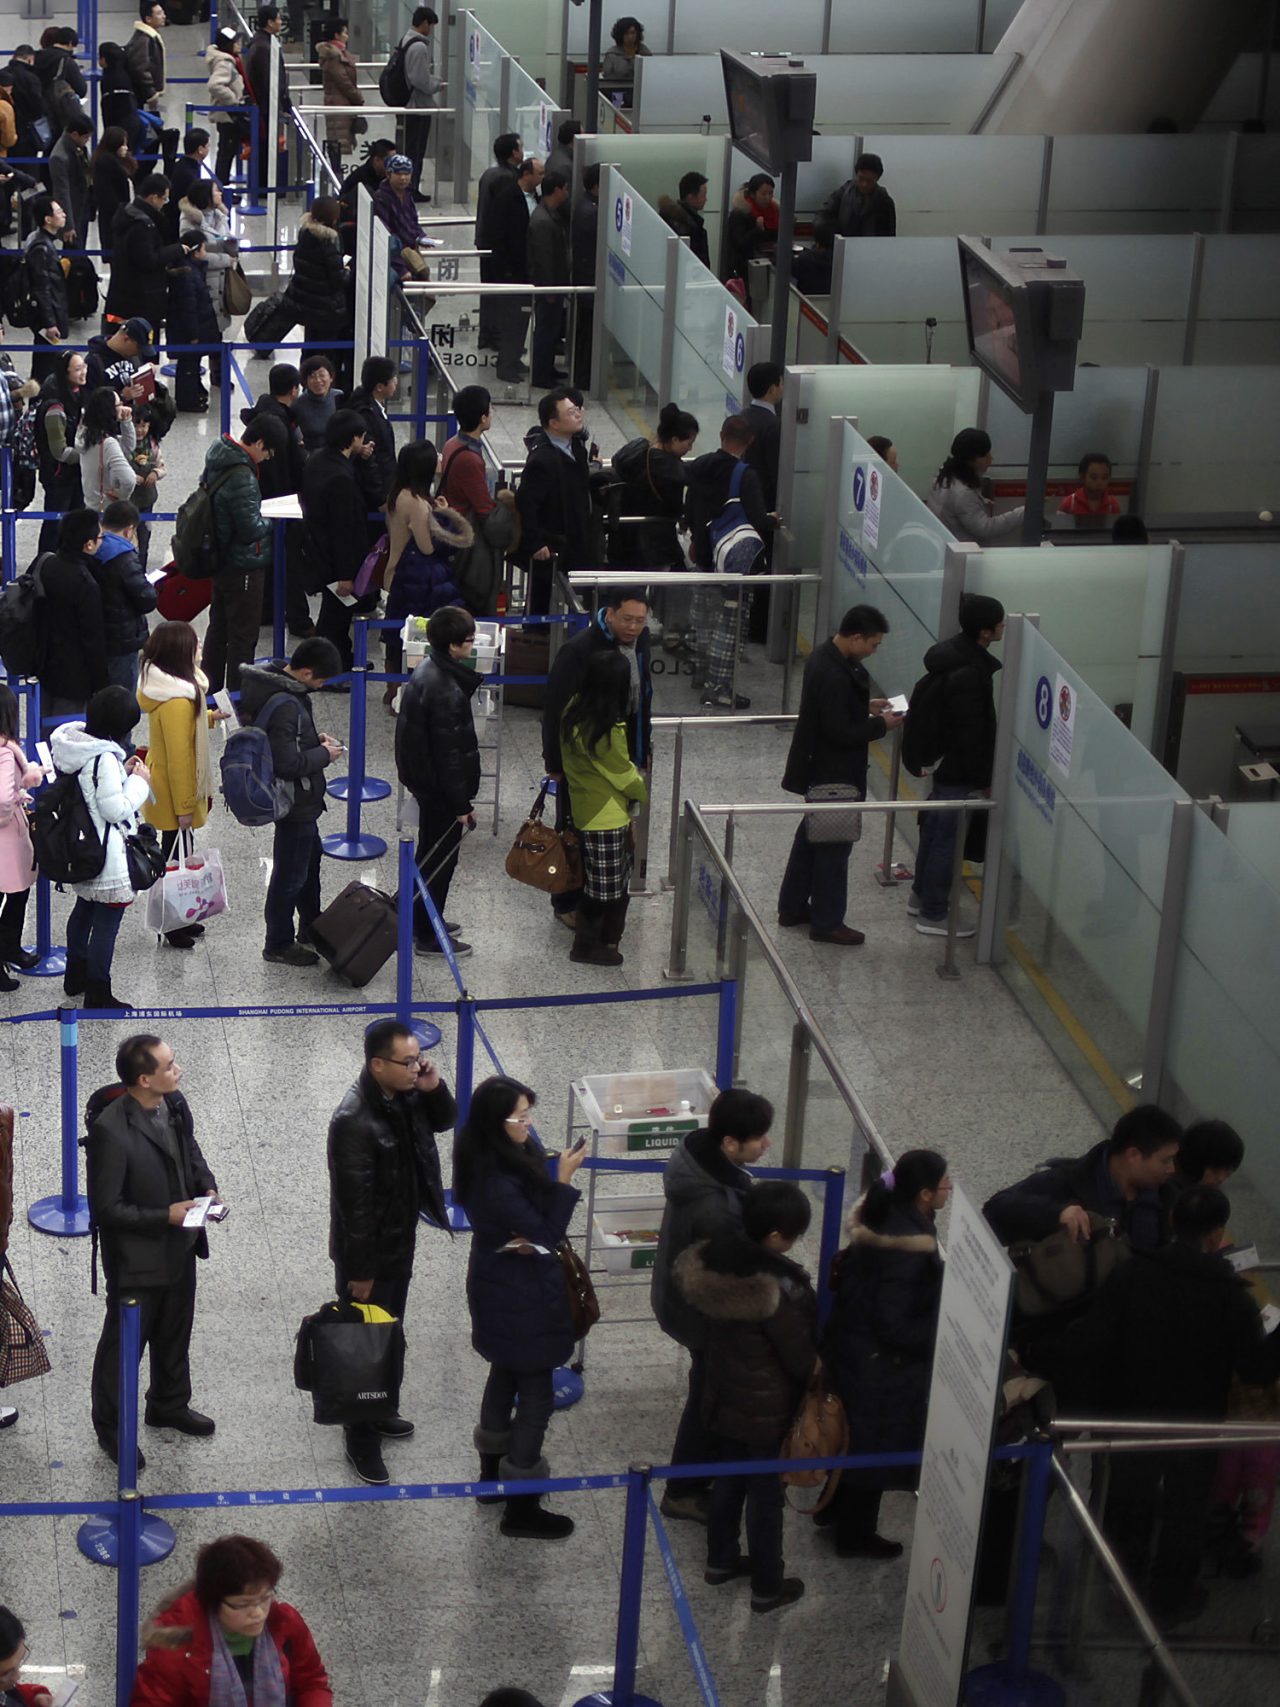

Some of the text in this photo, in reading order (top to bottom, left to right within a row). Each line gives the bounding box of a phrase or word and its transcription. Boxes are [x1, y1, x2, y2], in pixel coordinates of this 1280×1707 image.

[238, 1008, 268, 1016] SHANGHAI
[296, 1006, 340, 1015] INTERNATIONAL
[342, 1005, 367, 1013] AIRPORT
[645, 1138, 679, 1148] LIQUID
